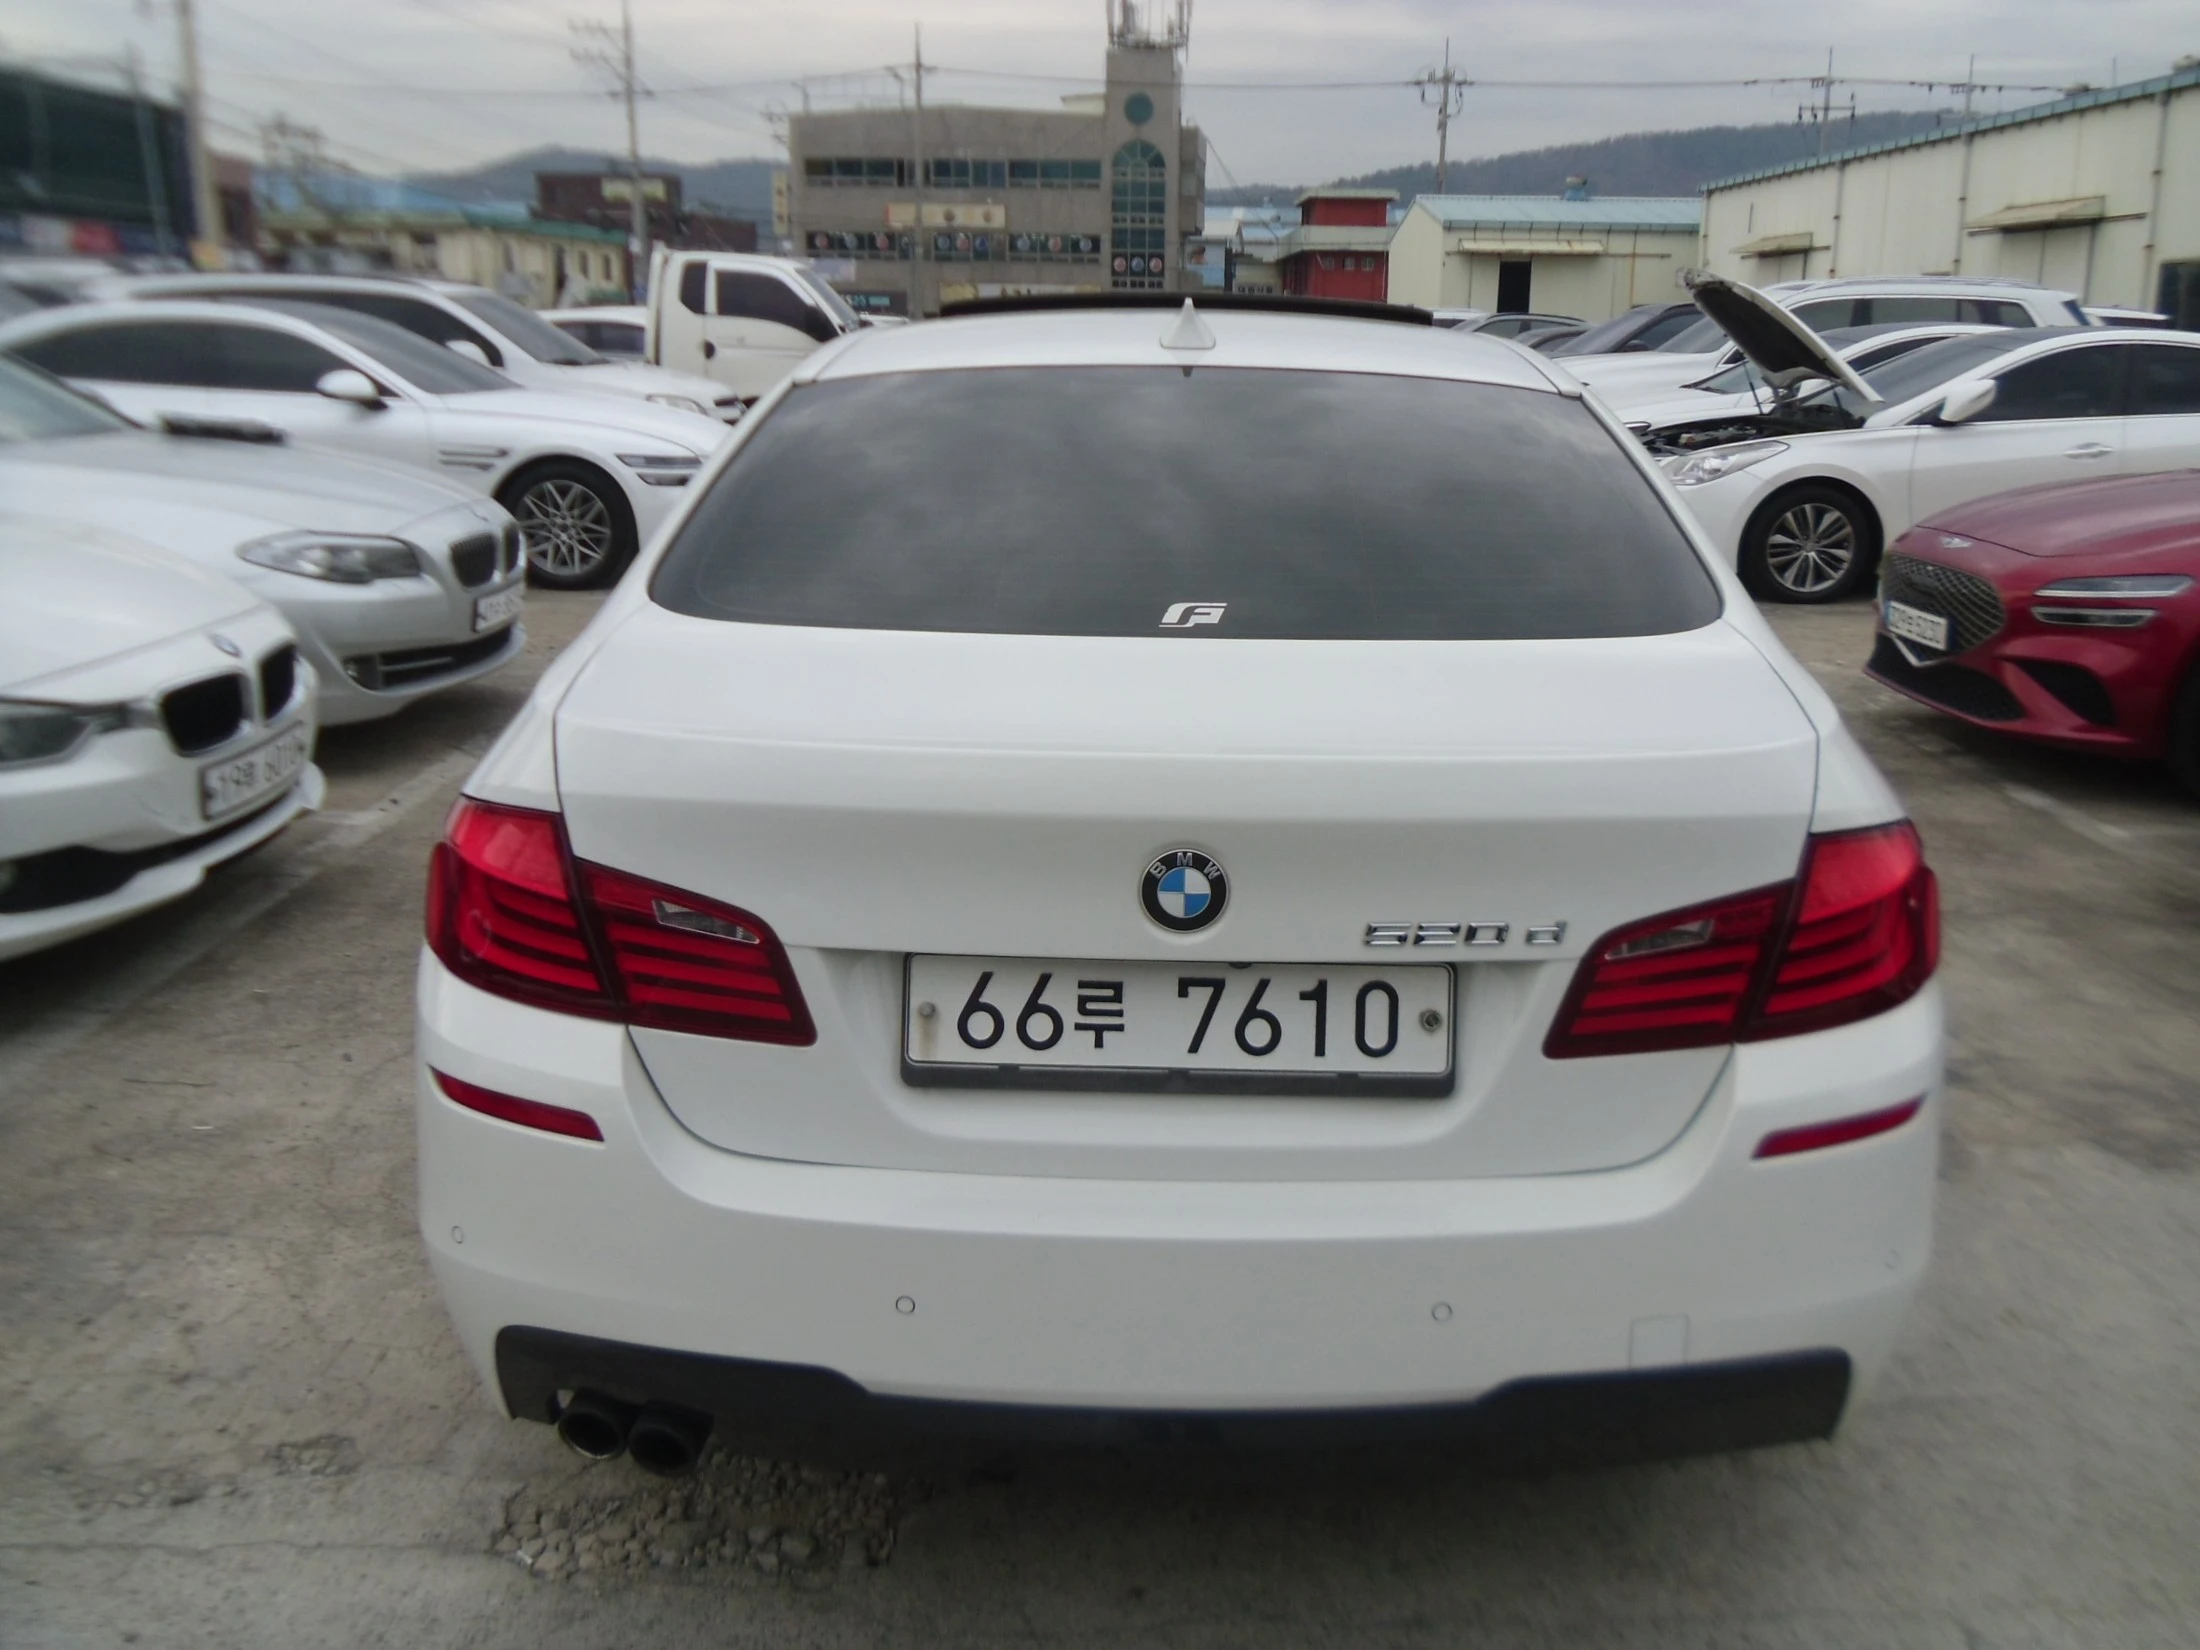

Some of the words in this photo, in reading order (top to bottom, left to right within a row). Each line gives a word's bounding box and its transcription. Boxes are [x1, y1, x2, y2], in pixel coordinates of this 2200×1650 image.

[1149, 852, 1221, 880] BMW
[957, 970, 1126, 1051] 66루
[1177, 977, 1400, 1058] 7610
